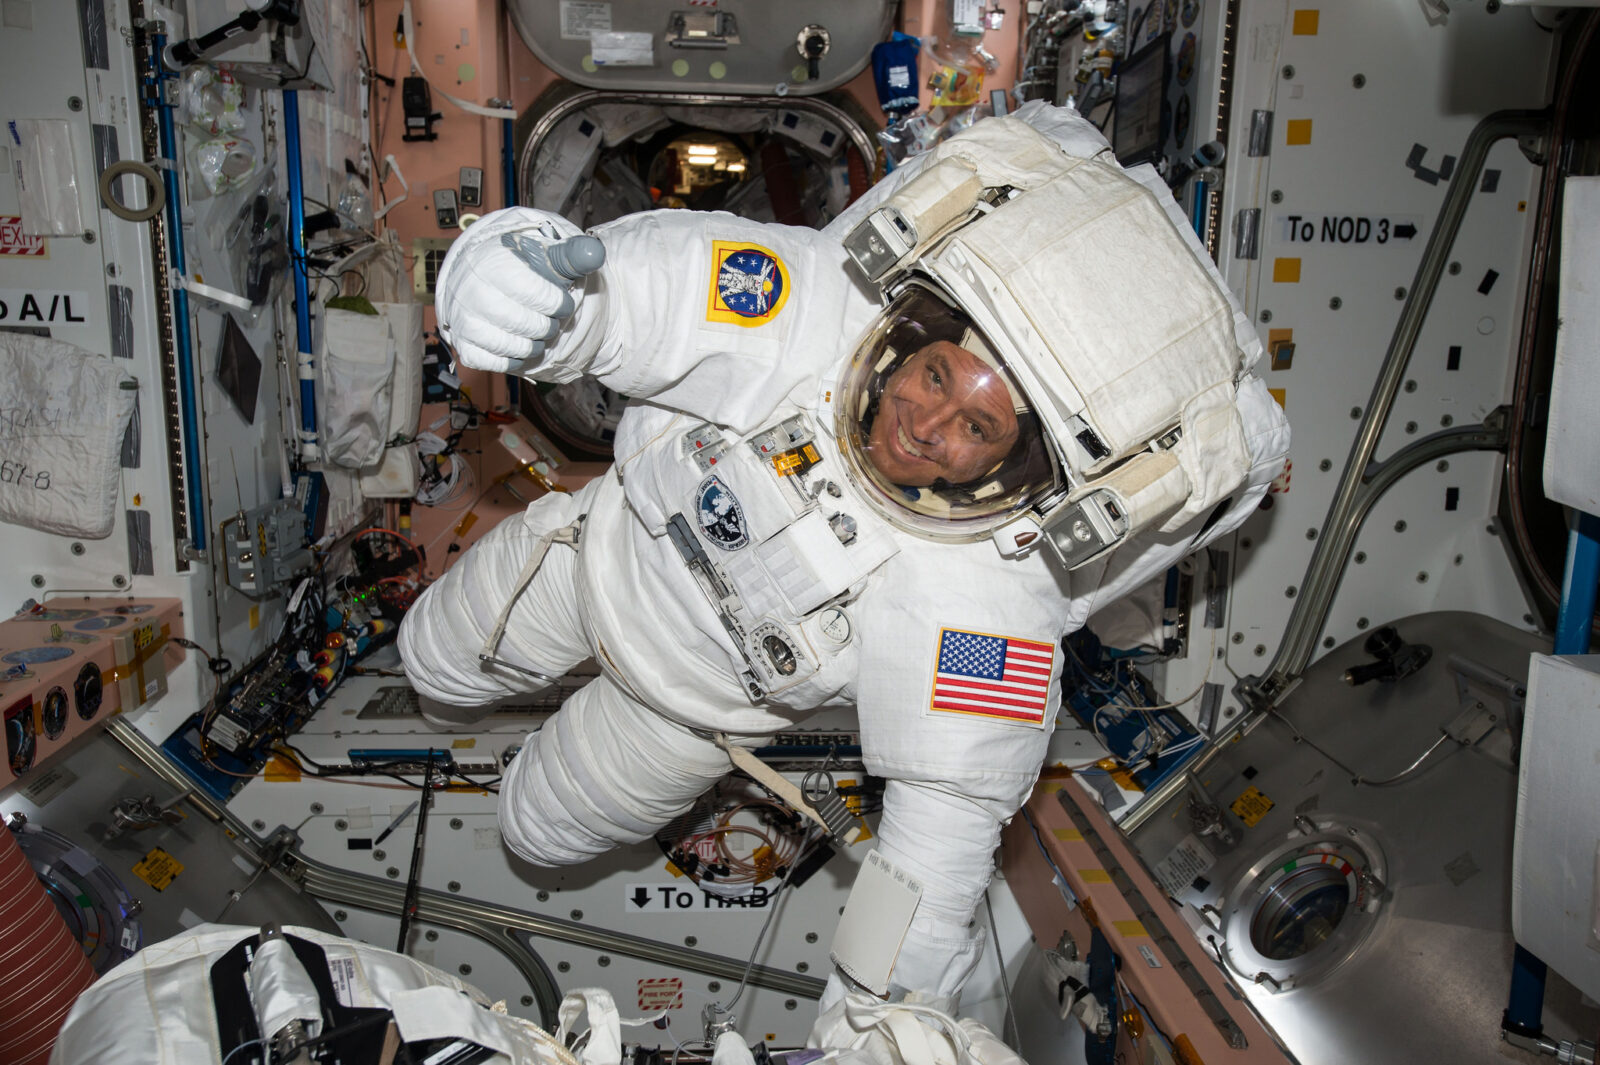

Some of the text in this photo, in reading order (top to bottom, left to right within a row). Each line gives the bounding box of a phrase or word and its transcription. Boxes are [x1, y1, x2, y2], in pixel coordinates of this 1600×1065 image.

[1288, 215, 1389, 244] To NOD 3
[19, 293, 85, 322] A/L
[1, 460, 50, 490] 67-8
[658, 887, 693, 908] To
